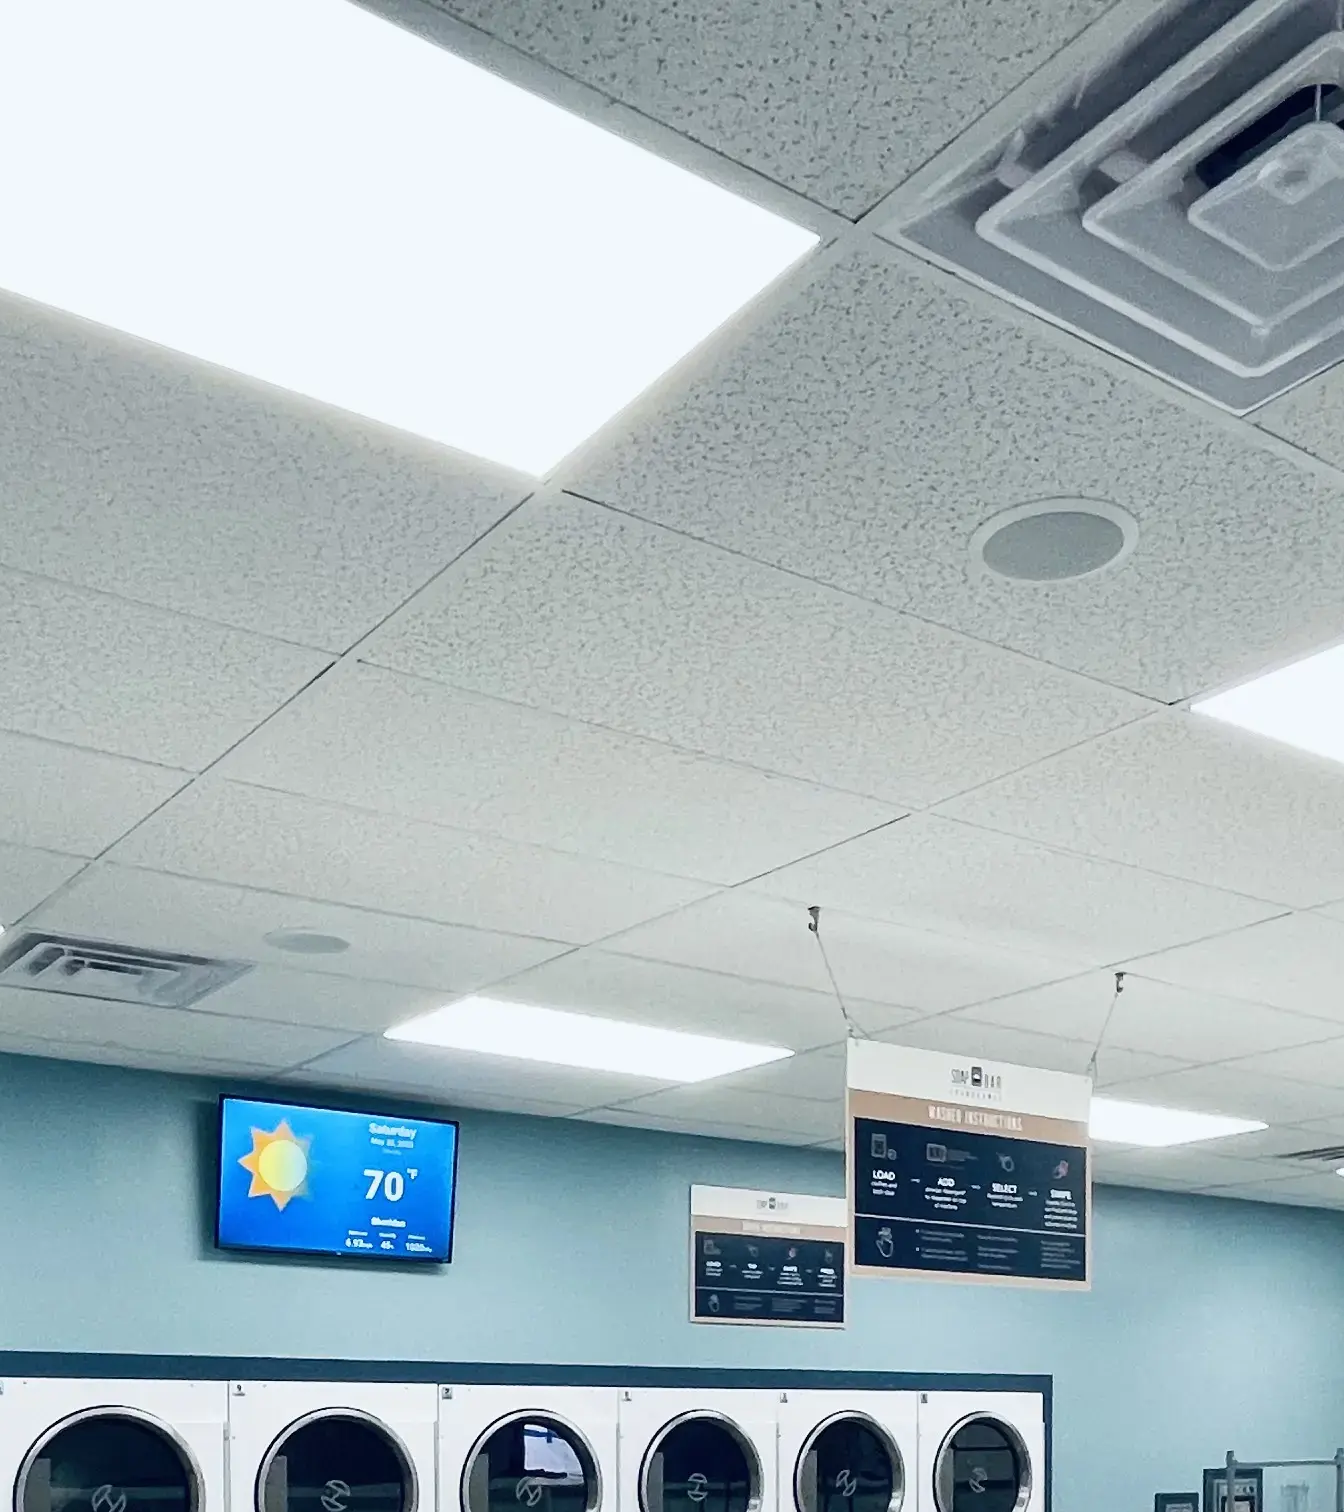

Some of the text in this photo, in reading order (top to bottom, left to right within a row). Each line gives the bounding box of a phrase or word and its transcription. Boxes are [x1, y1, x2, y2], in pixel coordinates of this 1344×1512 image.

[368, 1122, 418, 1140] Saturday
[872, 1169, 896, 1181] LOAD
[363, 1168, 404, 1202] 70
[991, 1182, 1018, 1194] SELECT
